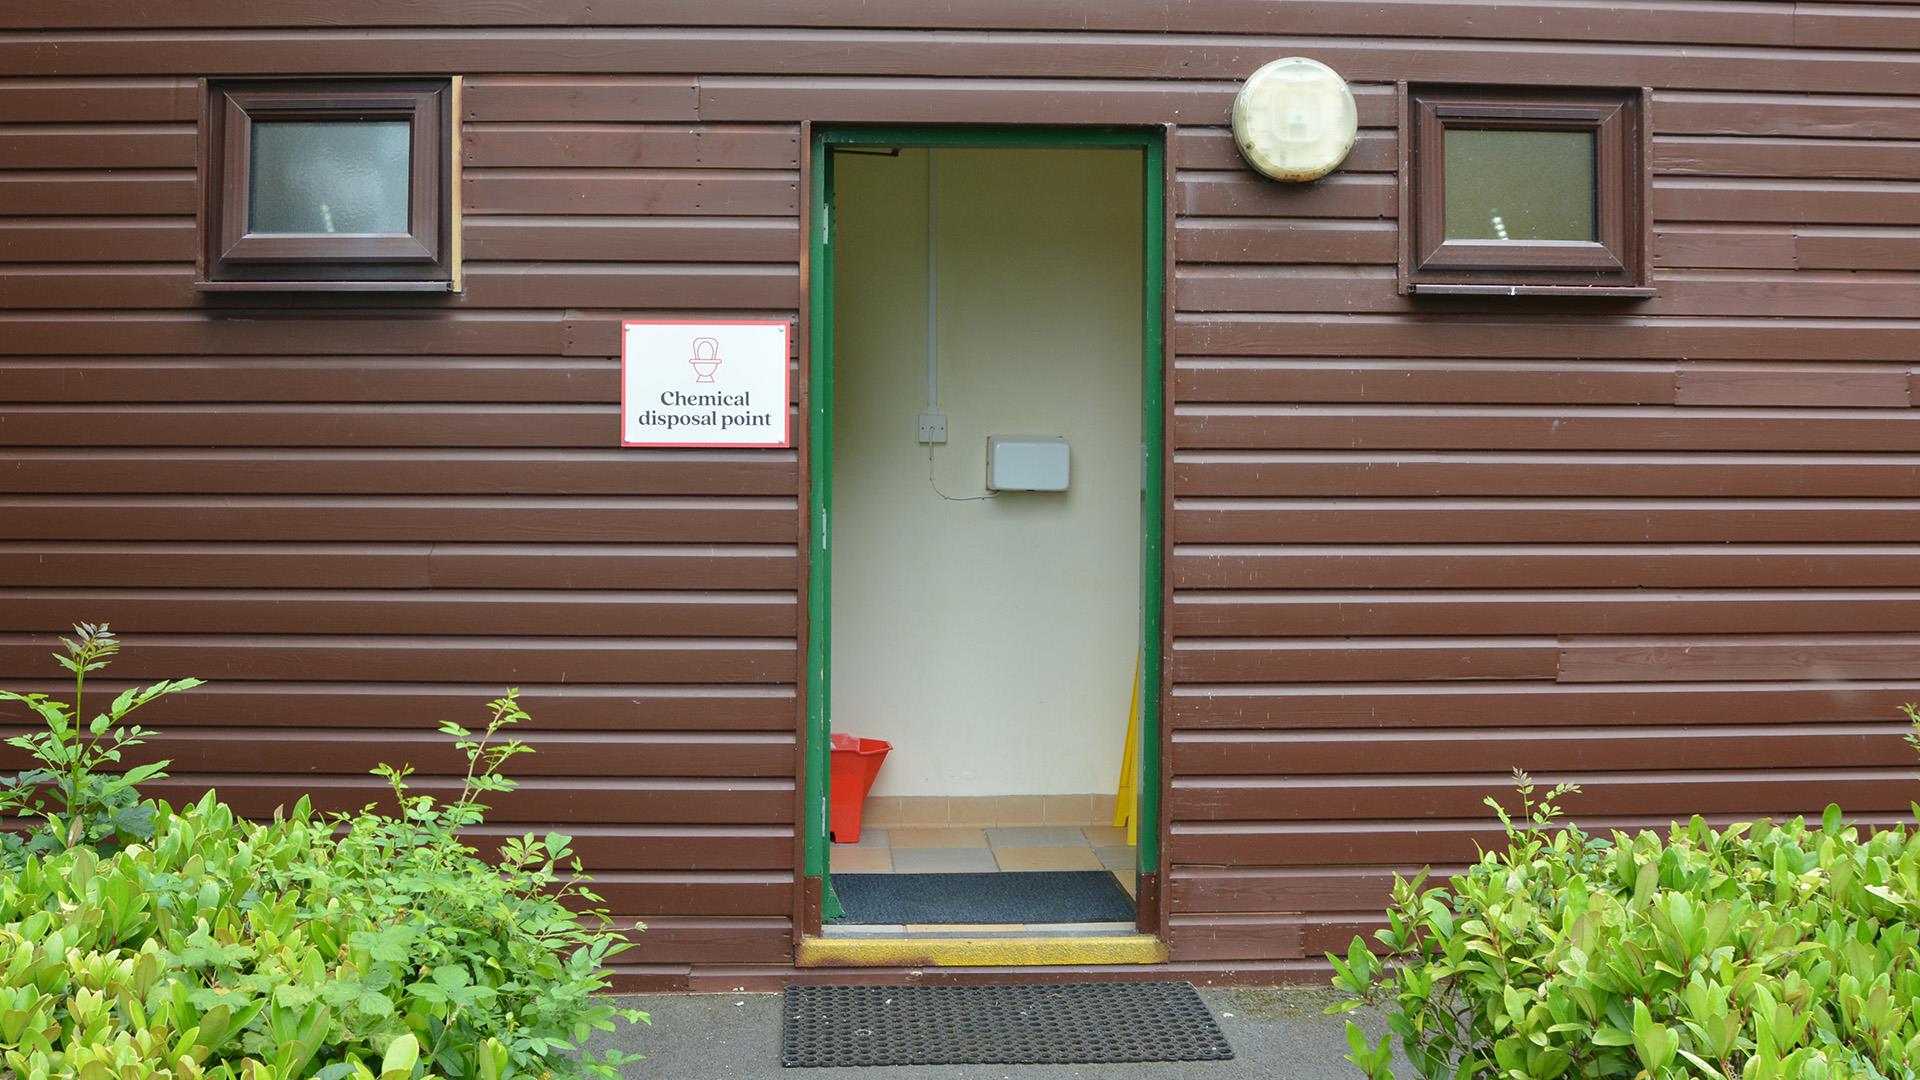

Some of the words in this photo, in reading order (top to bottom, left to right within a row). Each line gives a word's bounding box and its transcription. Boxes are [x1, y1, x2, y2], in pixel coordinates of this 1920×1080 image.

[660, 391, 749, 406] Chemical
[638, 410, 717, 430] disposal
[721, 410, 772, 430] point
